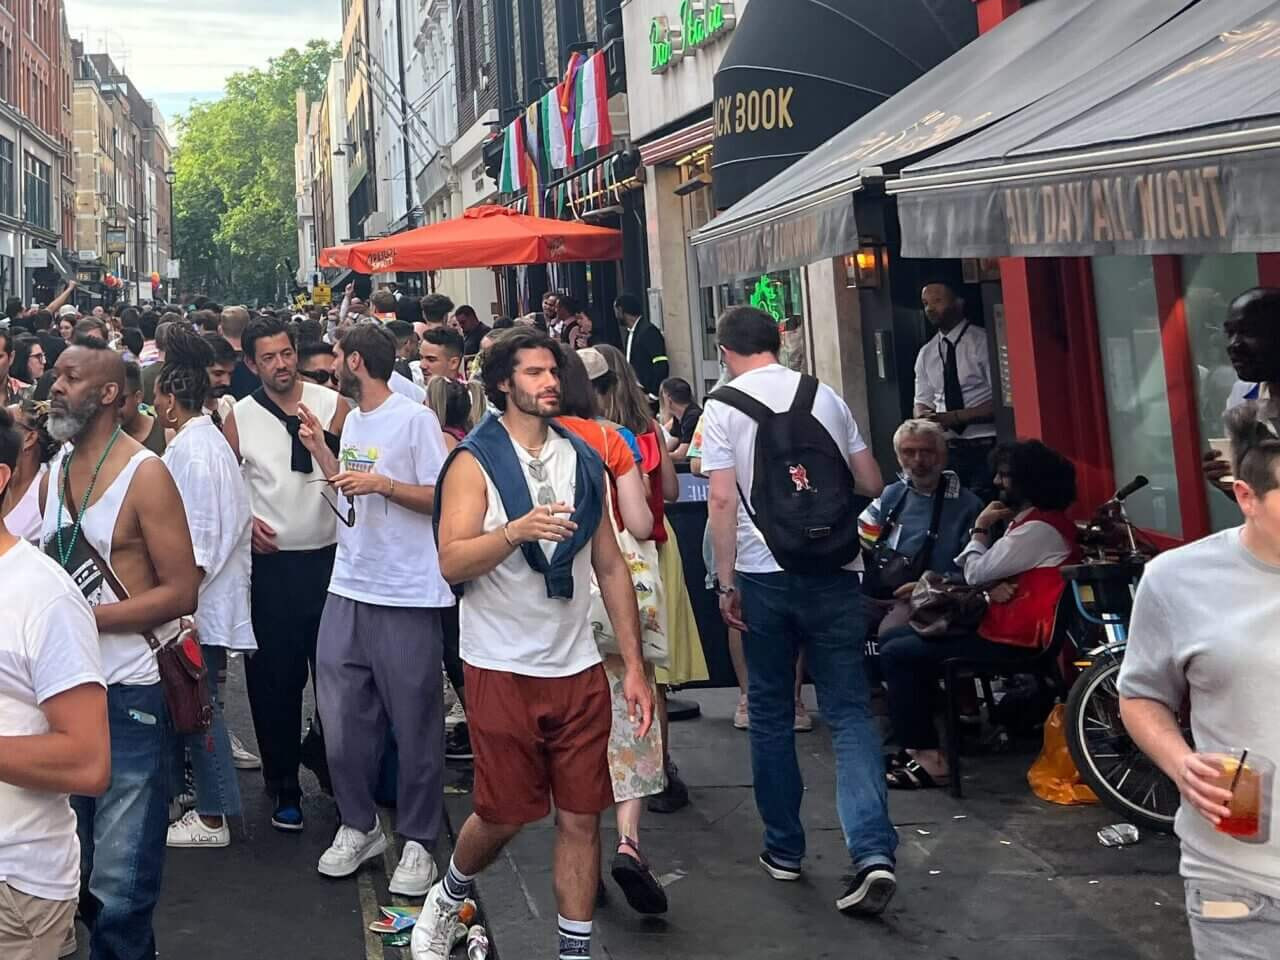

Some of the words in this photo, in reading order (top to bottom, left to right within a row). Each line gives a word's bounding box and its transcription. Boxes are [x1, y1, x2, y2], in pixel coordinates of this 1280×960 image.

[649, 19, 673, 70] Bar
[735, 86, 794, 134] BOOK
[1005, 188, 1037, 245] ALL
[1041, 182, 1083, 243] DAY
[1137, 166, 1228, 240] NIGHT
